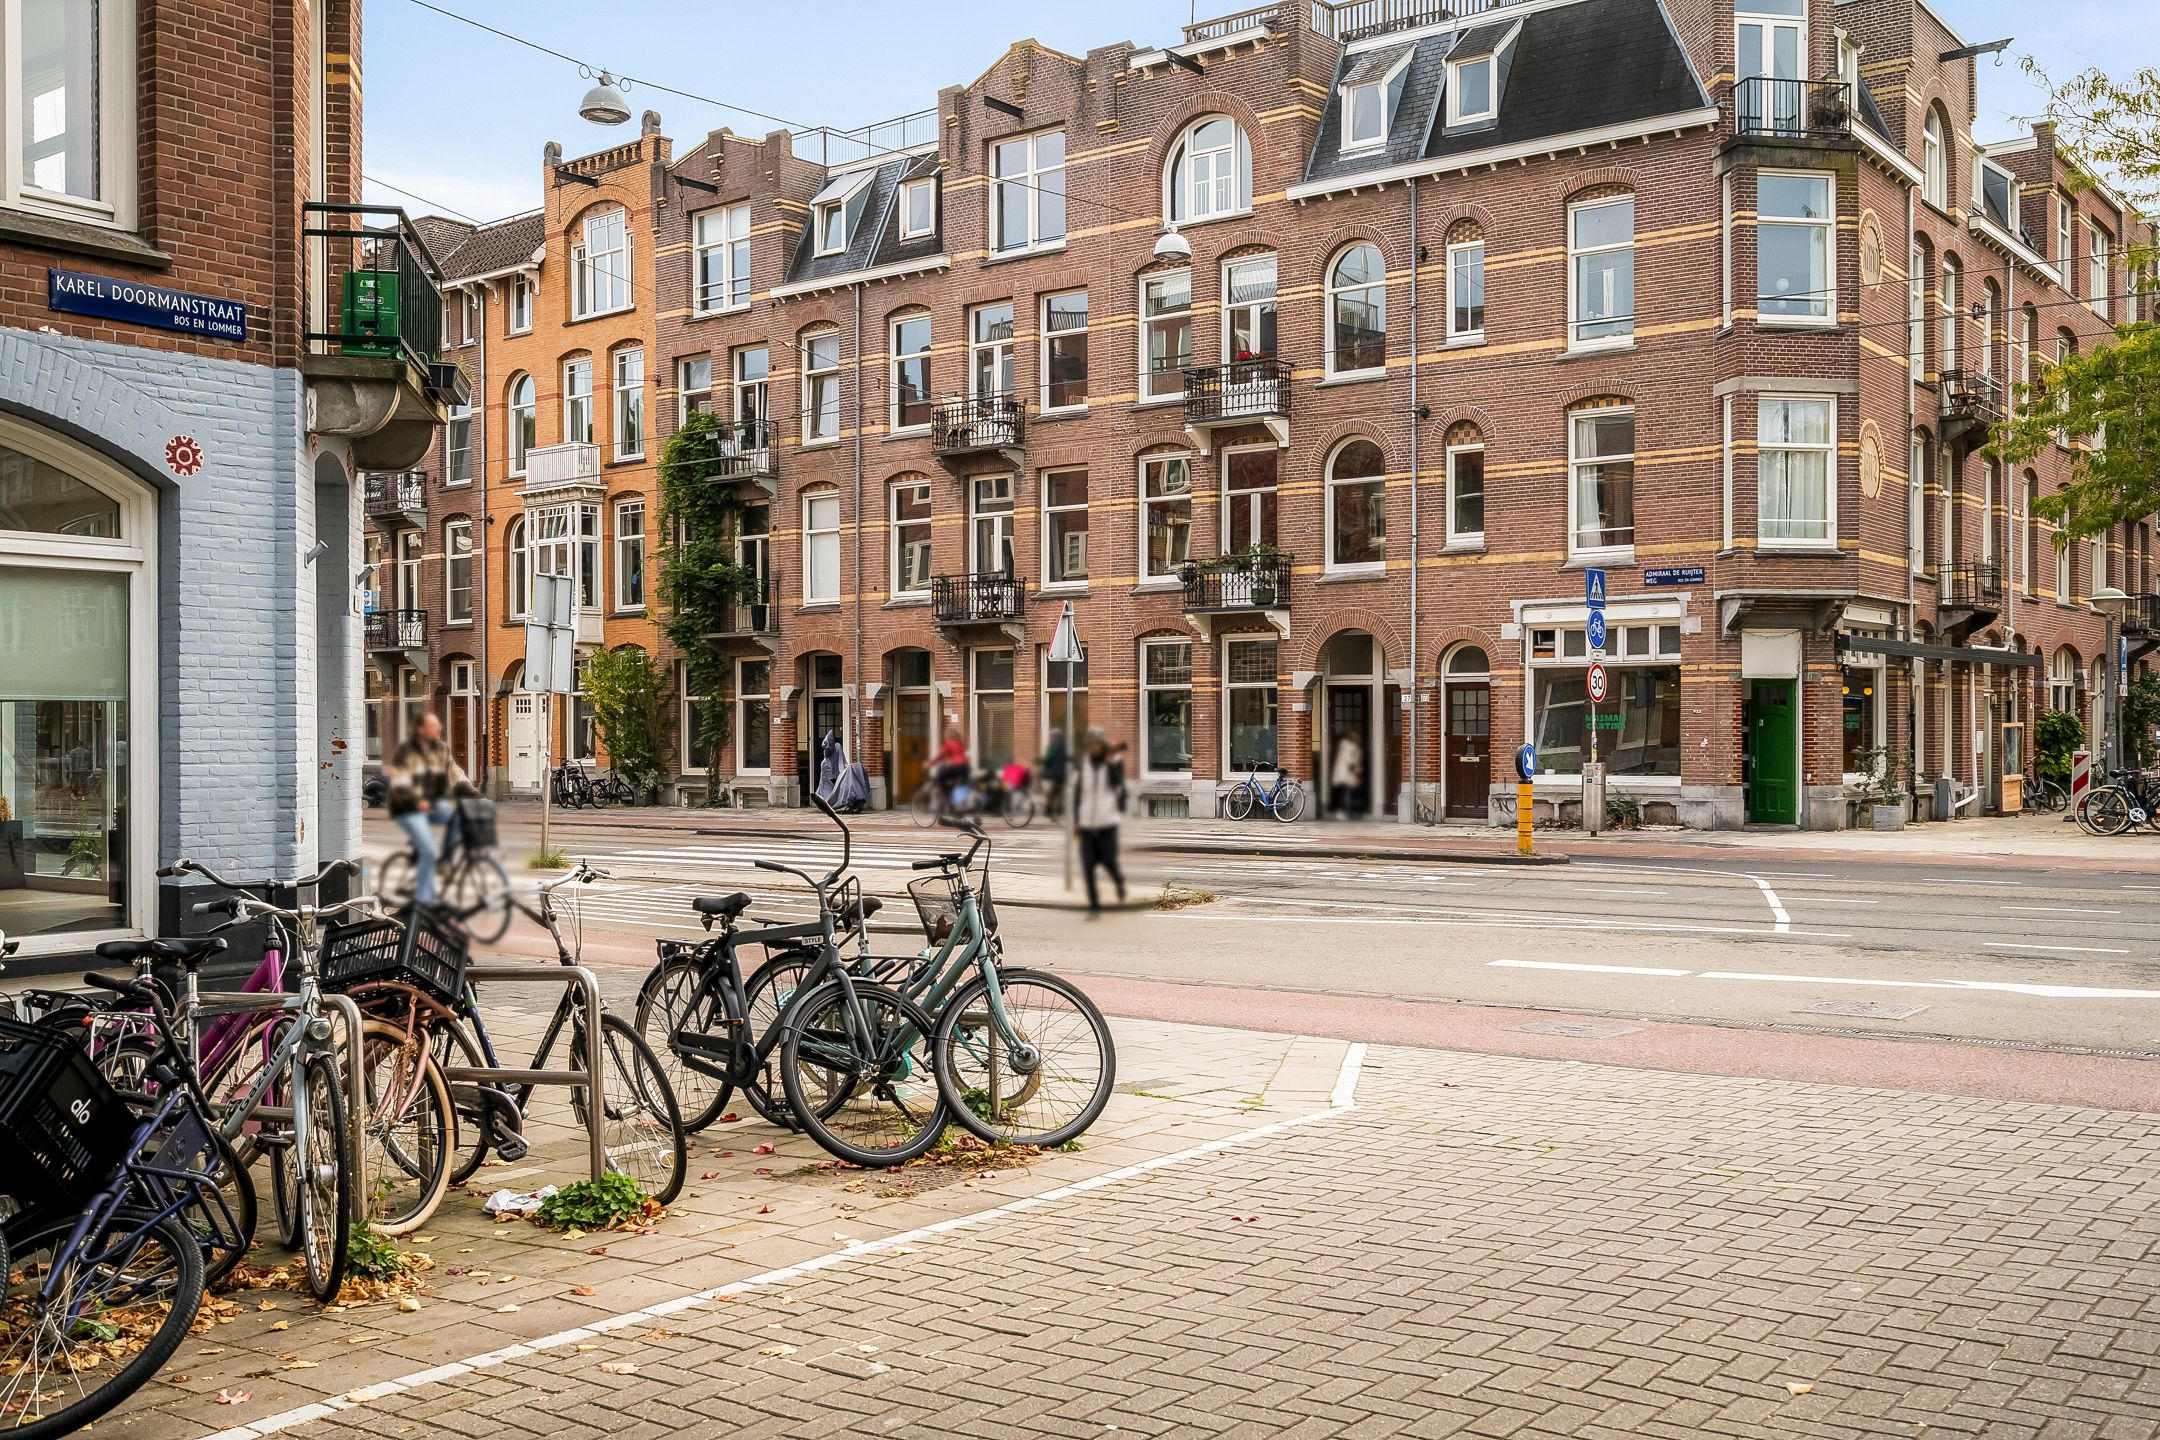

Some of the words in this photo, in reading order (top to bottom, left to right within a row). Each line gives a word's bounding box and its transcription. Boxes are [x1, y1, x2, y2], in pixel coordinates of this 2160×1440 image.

[56, 275, 104, 298] KAREL
[112, 284, 242, 321] DOORMANSTRAAT
[174, 315, 190, 327] BOS
[193, 318, 205, 329] EN
[208, 321, 243, 336] LOMMER
[1592, 675, 1603, 690] 30
[239, 1044, 285, 1112] Gazelle
